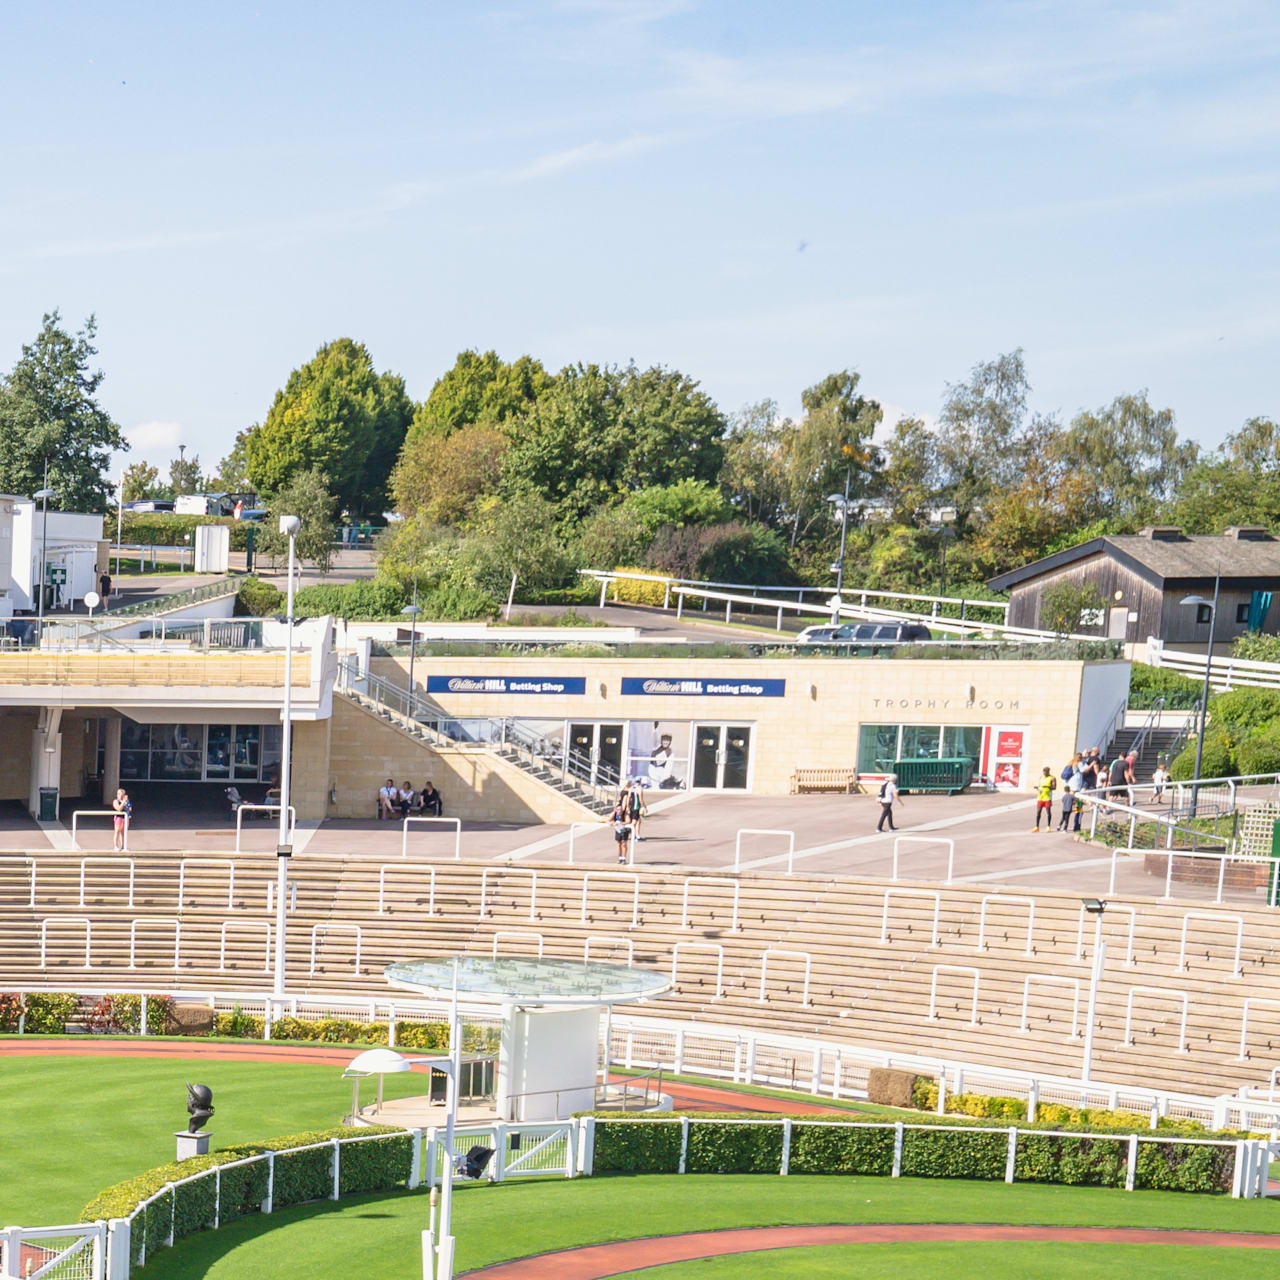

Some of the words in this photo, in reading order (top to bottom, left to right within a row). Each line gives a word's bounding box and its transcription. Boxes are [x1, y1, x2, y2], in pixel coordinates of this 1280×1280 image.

[485, 680, 506, 691] HILL
[510, 682, 541, 693] Betting
[542, 682, 564, 694] Shop
[681, 681, 702, 693] HILL
[706, 683, 738, 694] Betting
[740, 684, 763, 695] Shop
[873, 698, 950, 709] TROPHY
[965, 699, 1020, 710] ROOM
